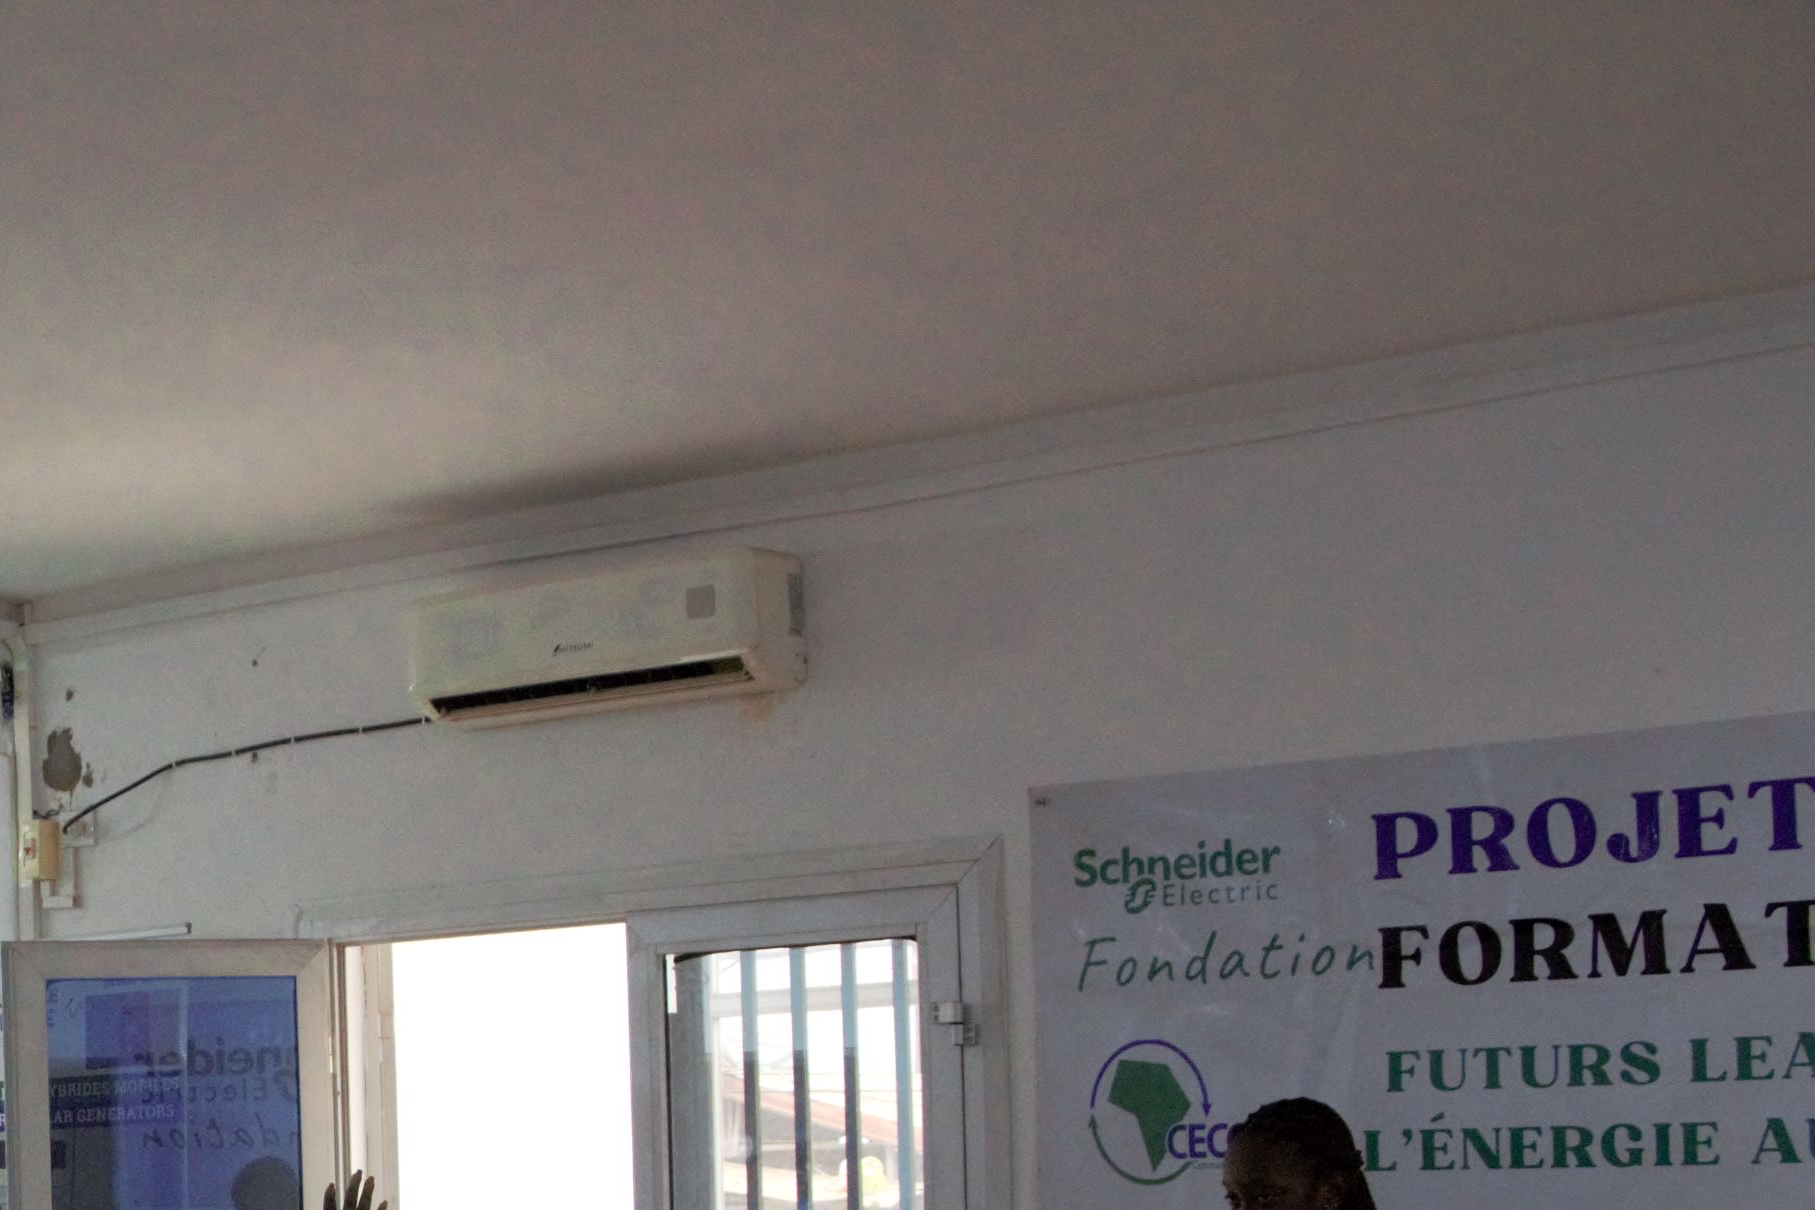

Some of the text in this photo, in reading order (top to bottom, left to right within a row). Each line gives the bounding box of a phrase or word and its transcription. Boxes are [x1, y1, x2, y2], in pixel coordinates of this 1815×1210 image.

[1371, 776, 1815, 881] PROJET
[1073, 838, 1281, 888] Schneider
[1162, 879, 1279, 908] Electric
[1077, 931, 1375, 992] Fondation
[1378, 899, 1815, 989] FORMAT
[1386, 1041, 1661, 1093] FUTURS
[1362, 1111, 1720, 1173] L'ÉNERGIE
